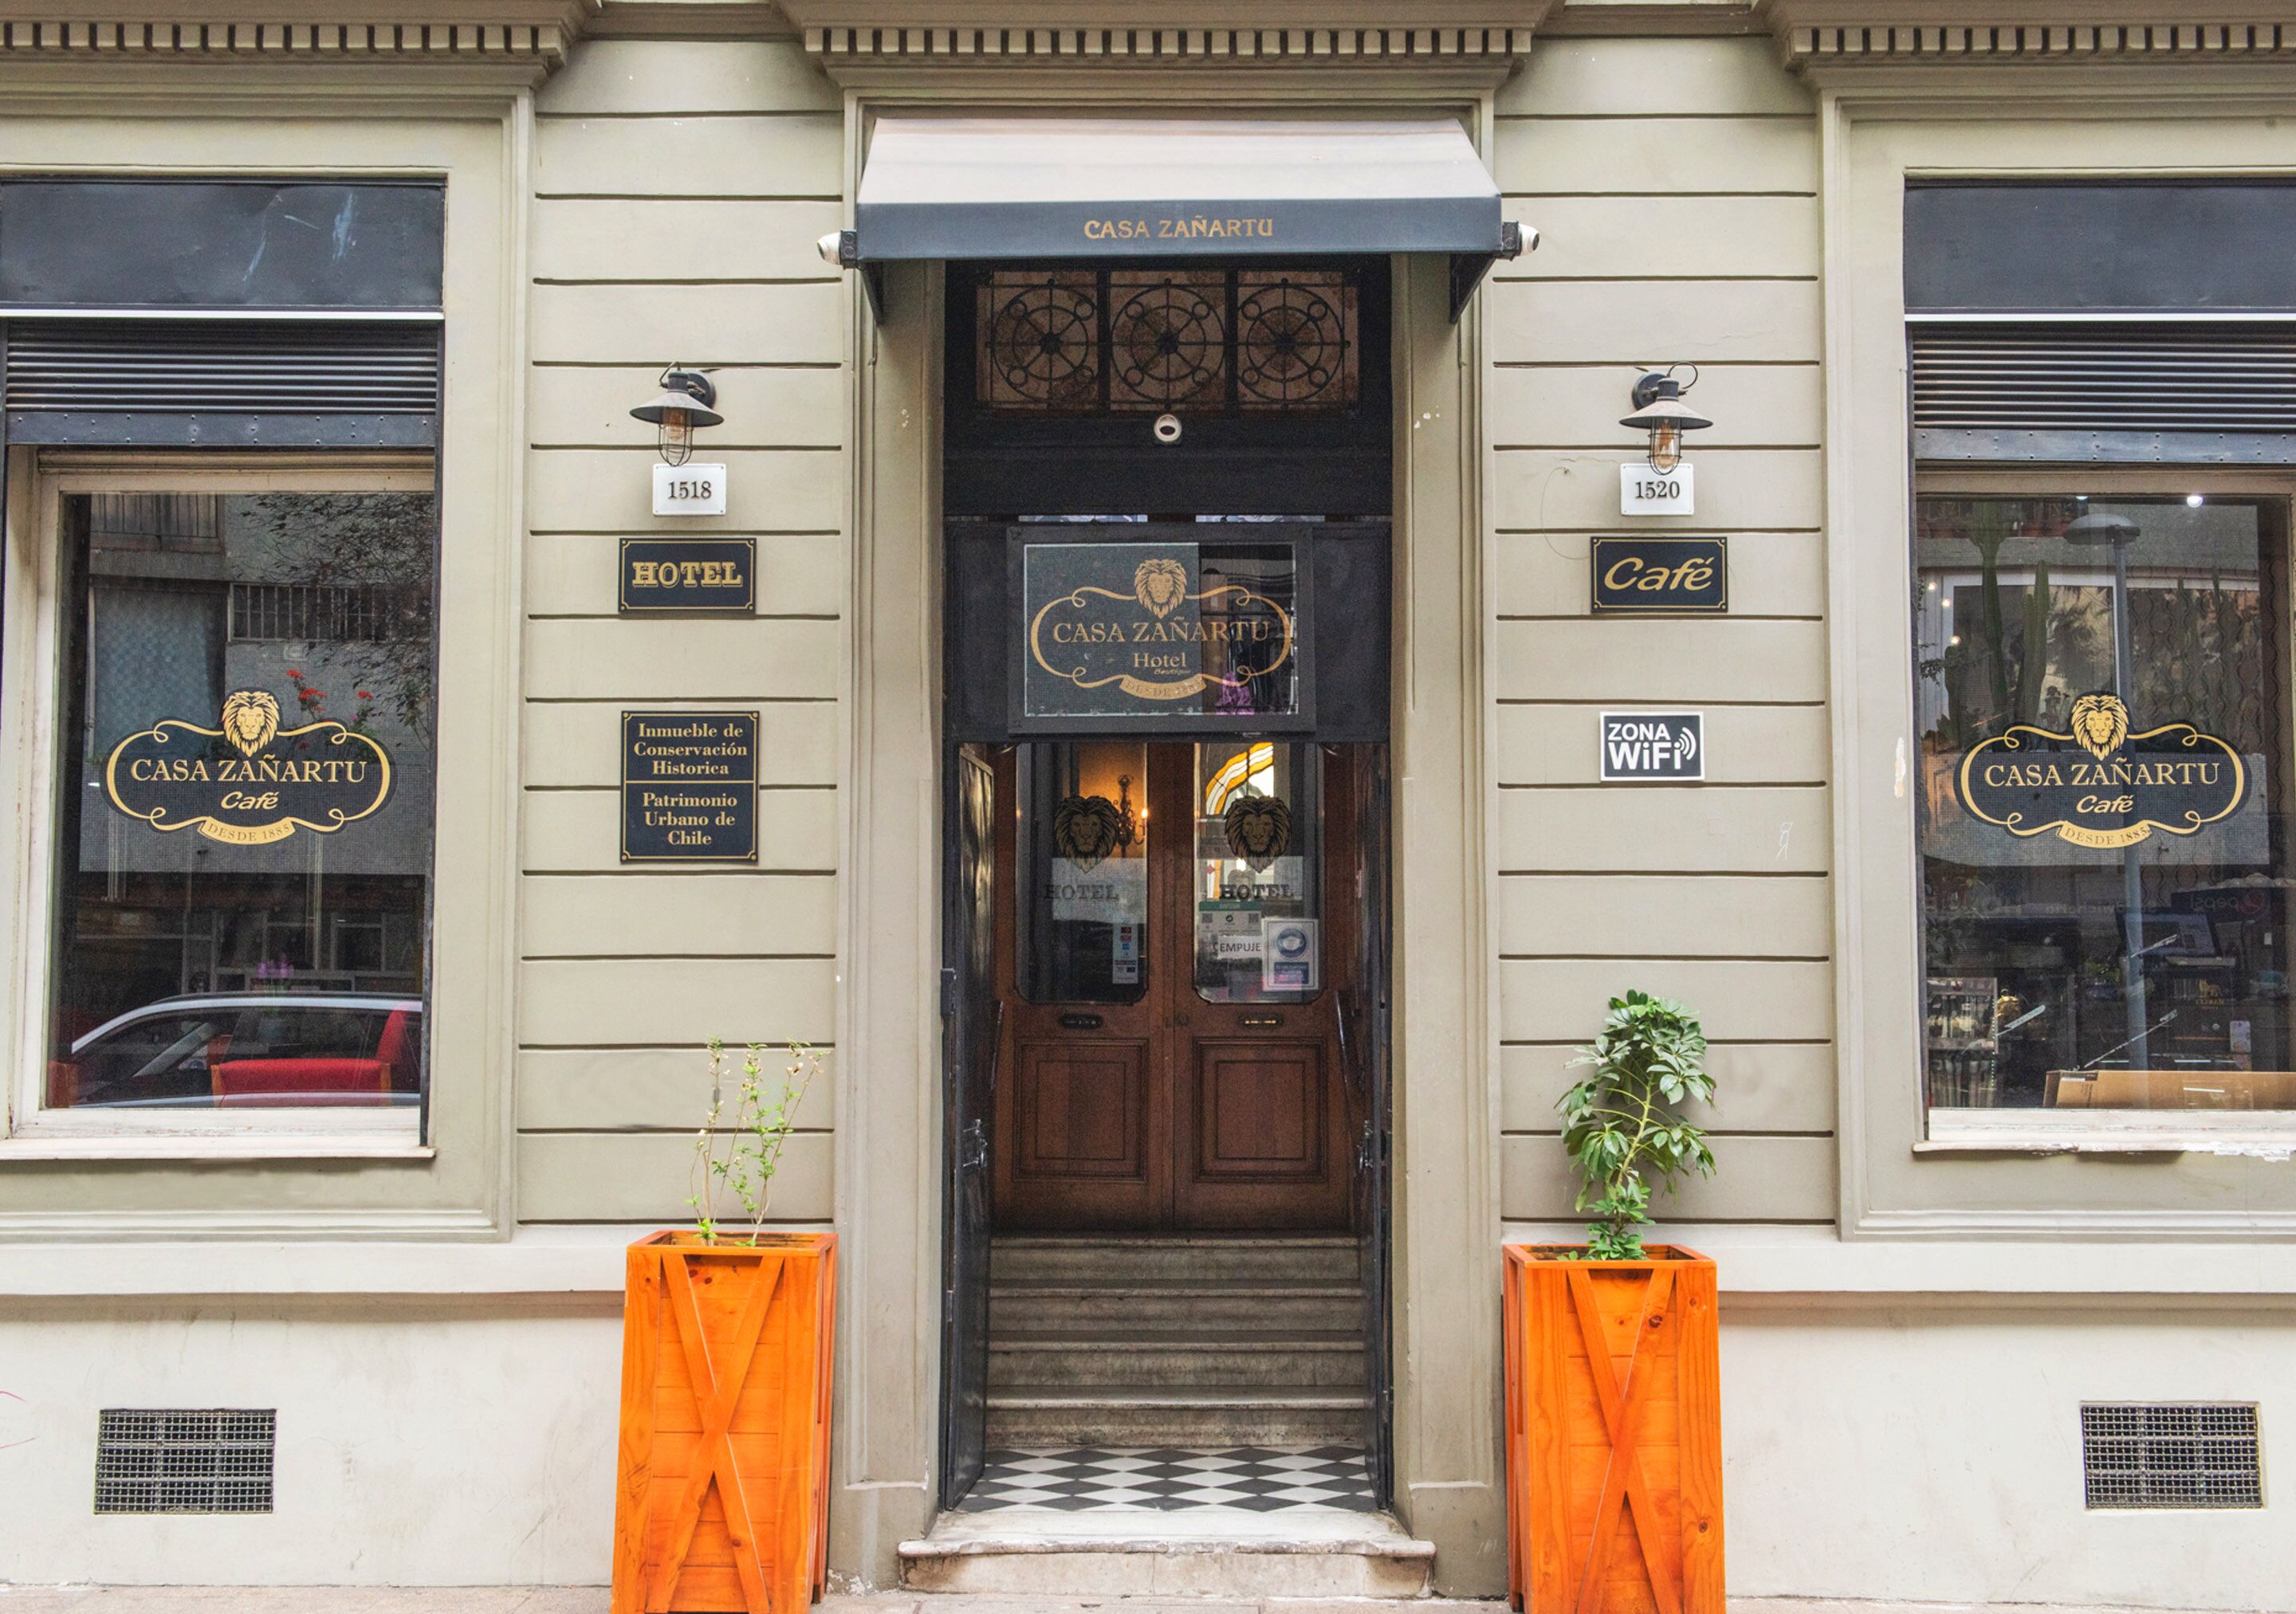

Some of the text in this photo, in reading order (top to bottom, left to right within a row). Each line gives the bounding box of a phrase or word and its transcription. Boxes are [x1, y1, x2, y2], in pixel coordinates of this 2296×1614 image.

[1083, 214, 1273, 239] CASA ZAÑARTU
[668, 481, 712, 500] 1518
[1635, 481, 1681, 500] 1520
[632, 562, 743, 587] HOTEL
[1604, 557, 1714, 591] Café
[1053, 617, 1269, 643] CASA ZAÑARTU
[1134, 651, 1187, 668] Hotel
[639, 723, 743, 737] Inmueble de
[1608, 723, 1670, 741] ZONA
[634, 741, 748, 756] Conservación
[1608, 741, 1682, 770] WiFi
[131, 755, 367, 783] CASA ZAÑARTU
[652, 760, 729, 775] Historica
[1983, 756, 2219, 787] CASA ZAÑARTU
[220, 791, 281, 810] Café
[643, 792, 737, 807] Patrimonio
[2076, 795, 2134, 814] Café
[645, 811, 735, 827] Urbano de
[207, 823, 289, 842] DESDE 1885
[667, 830, 712, 846] Chile
[2065, 826, 2148, 845] DESDE 1885
[1044, 885, 1119, 900] HOTEL
[1219, 883, 1293, 900] HOTEL
[1219, 942, 1262, 953] EMPUJE
